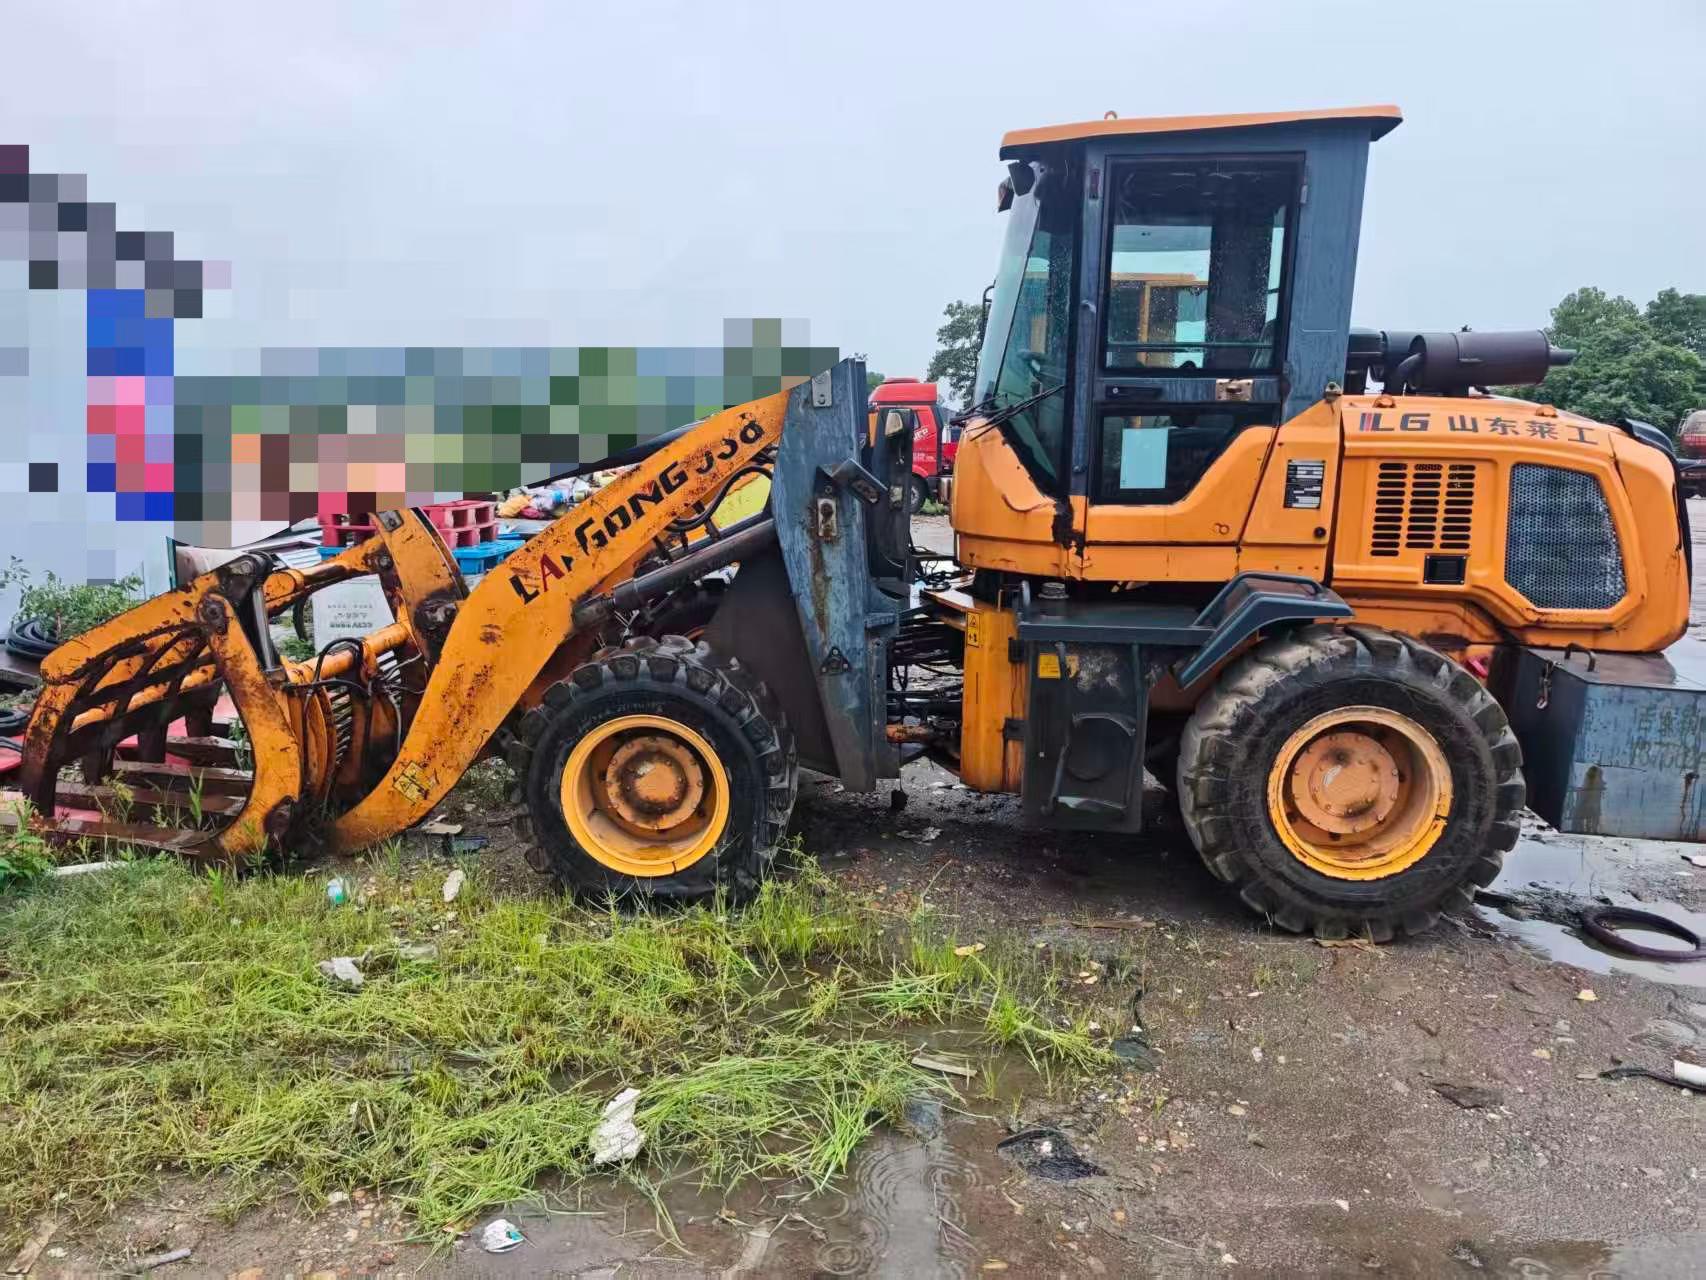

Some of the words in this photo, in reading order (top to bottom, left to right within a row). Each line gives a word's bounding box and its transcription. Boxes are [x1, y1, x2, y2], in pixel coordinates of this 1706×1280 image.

[1369, 412, 1431, 432] LG
[1448, 414, 1599, 446] 山东莱工
